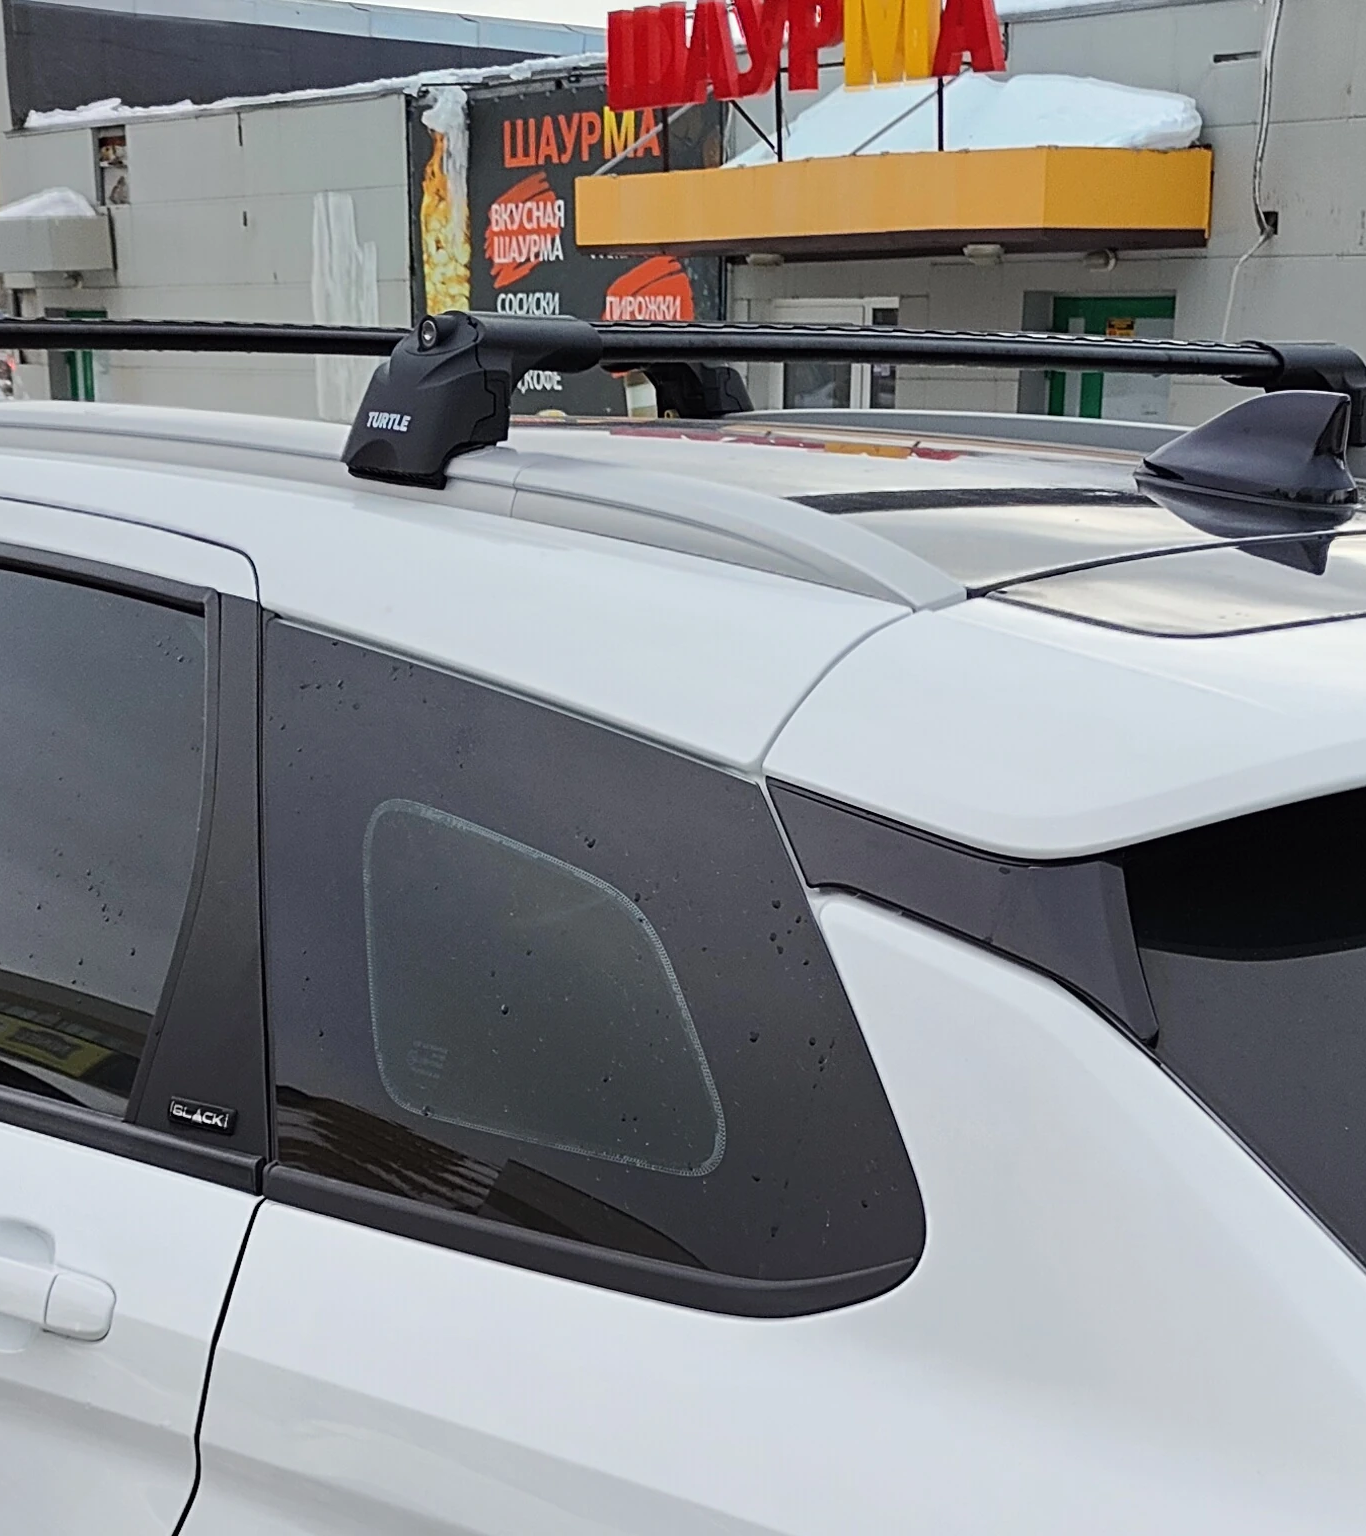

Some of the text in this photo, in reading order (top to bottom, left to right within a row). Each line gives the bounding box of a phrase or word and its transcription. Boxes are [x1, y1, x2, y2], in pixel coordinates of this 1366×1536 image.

[607, 0, 1006, 110] ШАУРМА
[503, 106, 661, 169] ШАУРМА
[490, 199, 566, 232] ВКУСНАЯ
[493, 235, 565, 264] ШАУРМА
[496, 292, 560, 315] СОСИСКИ
[605, 296, 682, 320] ПИРОЖКИ
[366, 411, 412, 432] TURTLE
